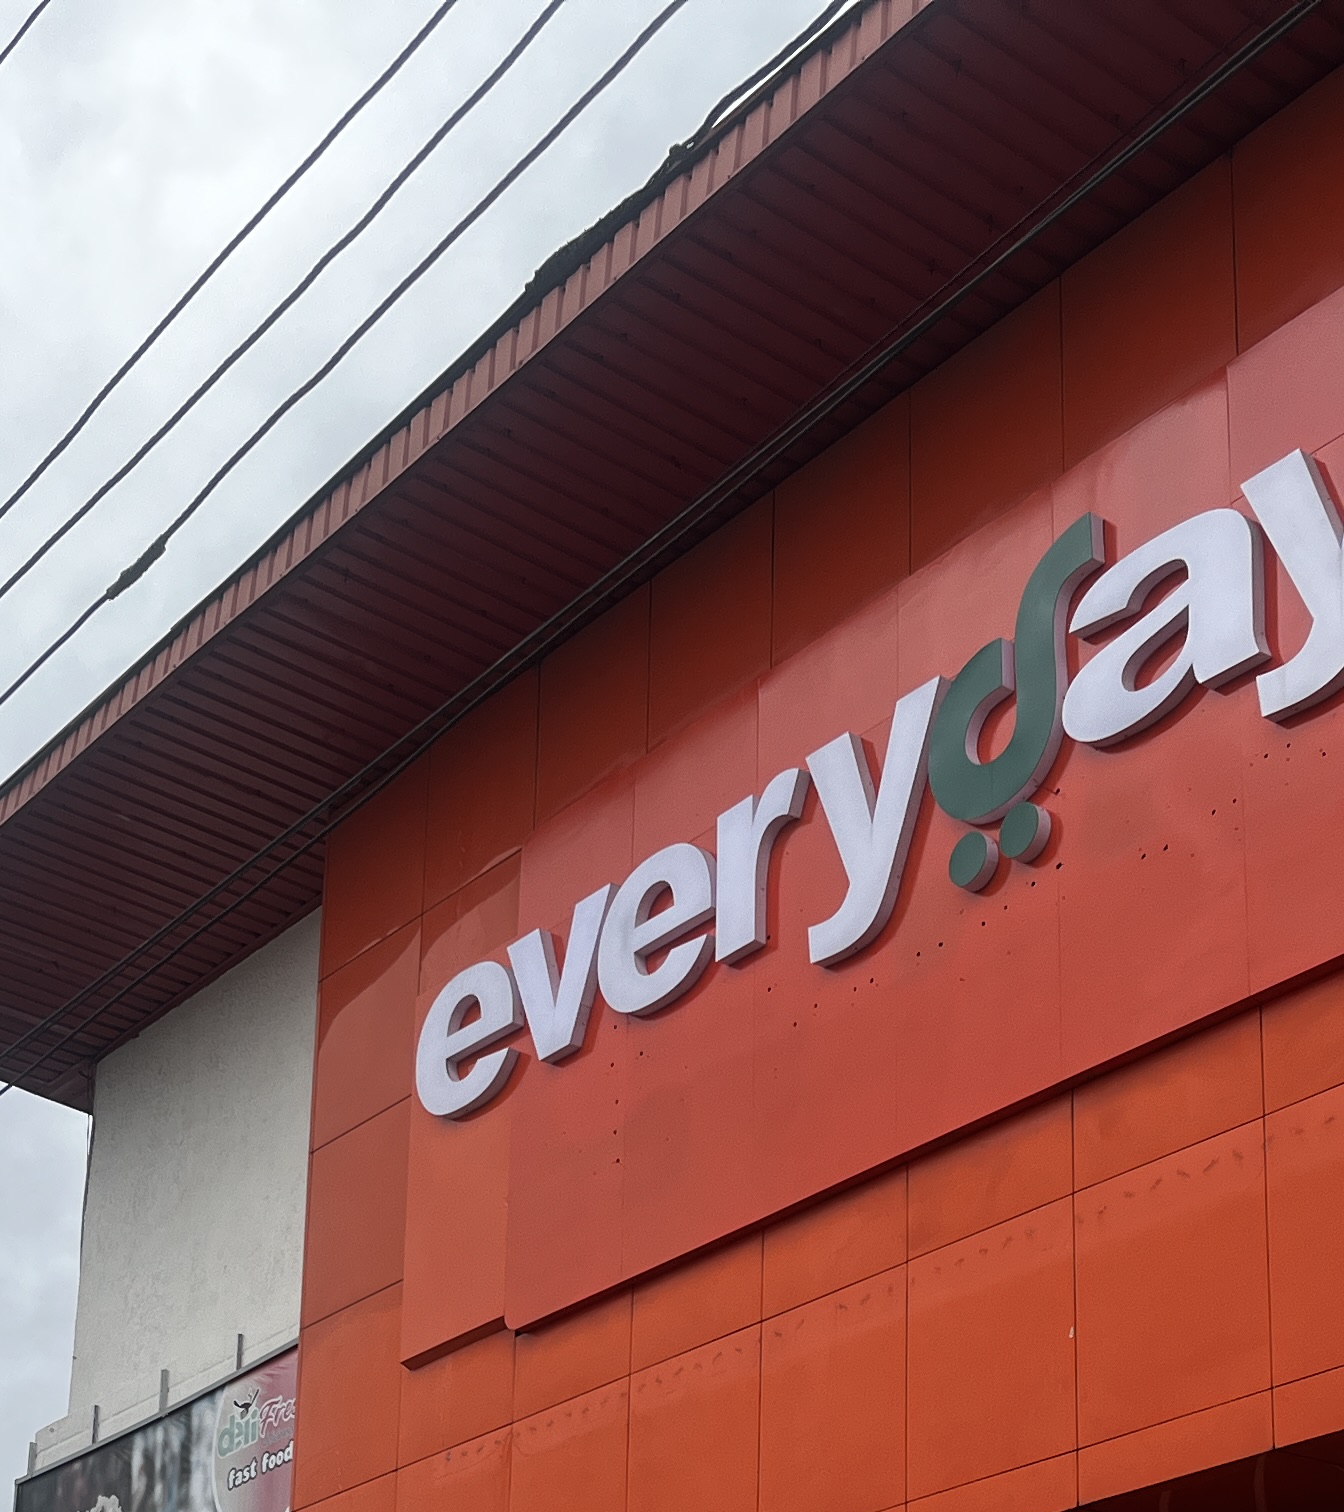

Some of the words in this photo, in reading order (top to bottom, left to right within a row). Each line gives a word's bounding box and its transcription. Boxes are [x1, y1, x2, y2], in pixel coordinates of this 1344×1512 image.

[217, 1407, 259, 1459] deli
[227, 1457, 258, 1491] fast
[261, 1439, 295, 1474] food
